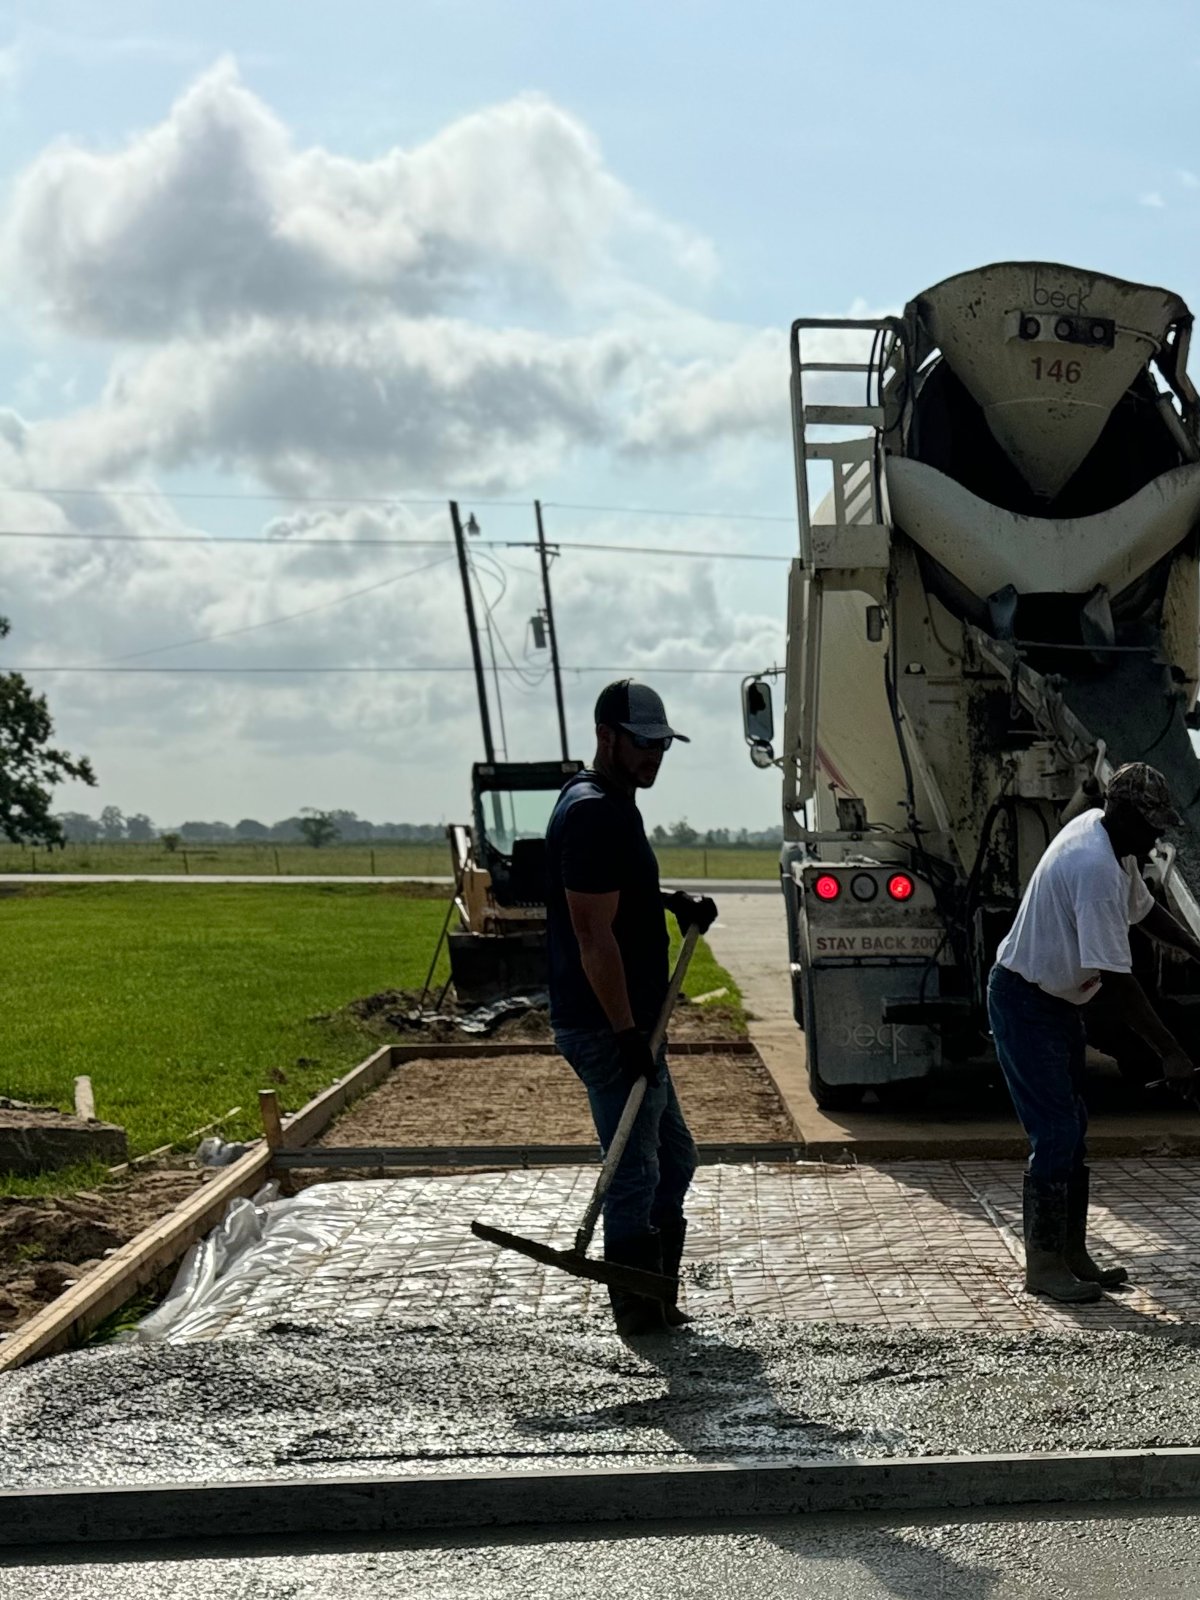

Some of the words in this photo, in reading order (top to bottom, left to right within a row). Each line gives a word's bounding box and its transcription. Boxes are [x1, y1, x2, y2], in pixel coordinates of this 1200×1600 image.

[1033, 268, 1090, 316] beck
[1030, 356, 1081, 384] 146
[816, 936, 856, 951] STAY
[861, 936, 906, 950] BACK
